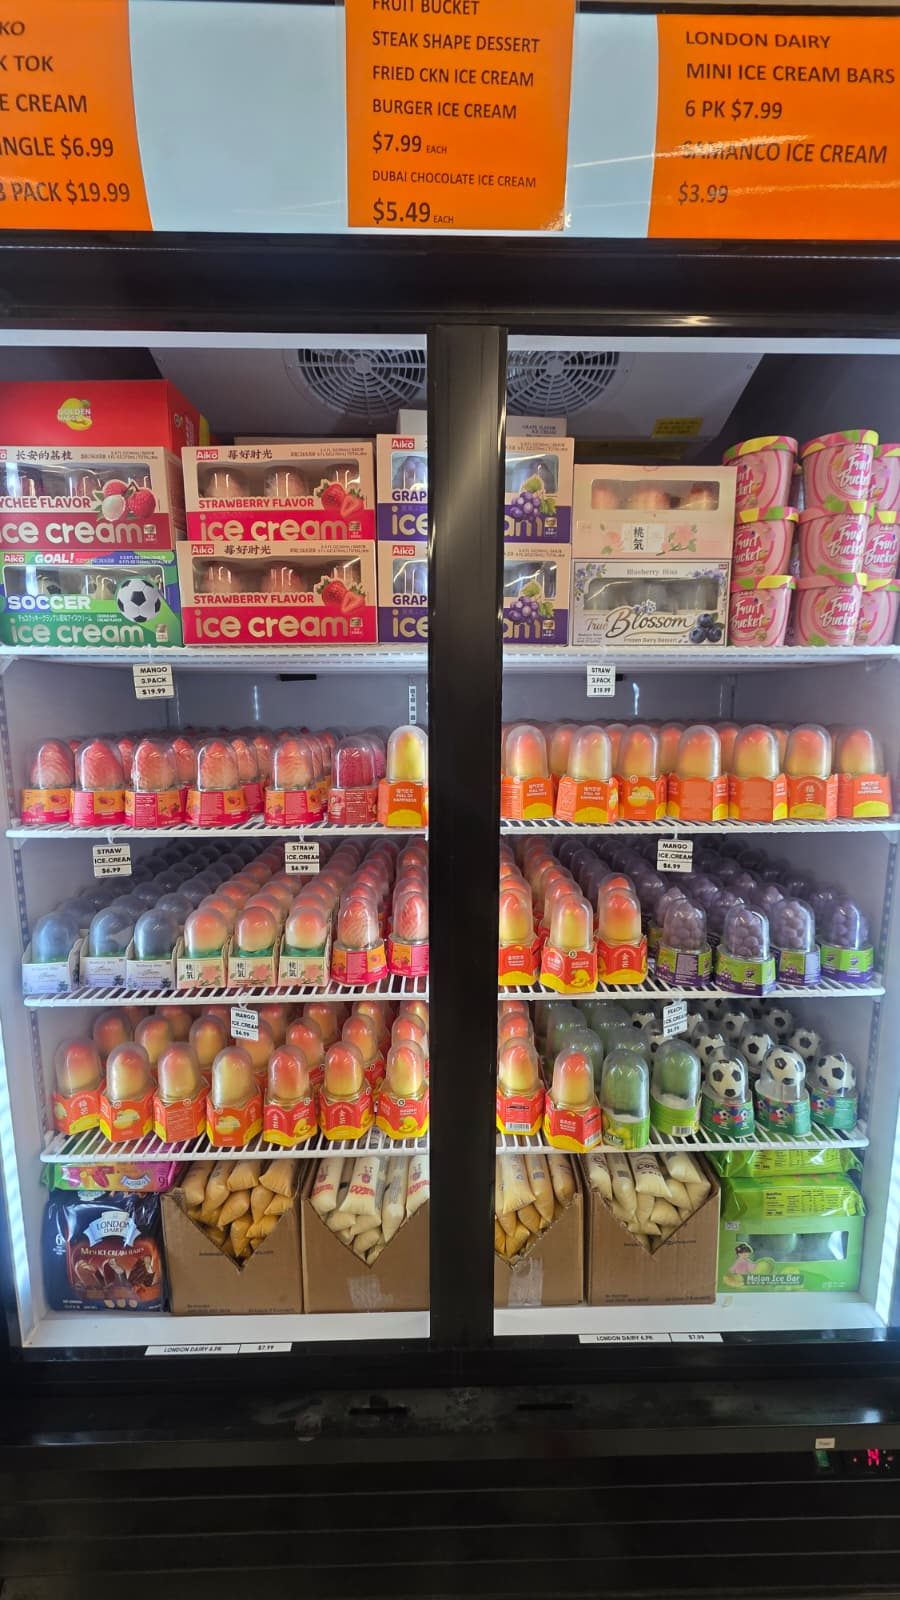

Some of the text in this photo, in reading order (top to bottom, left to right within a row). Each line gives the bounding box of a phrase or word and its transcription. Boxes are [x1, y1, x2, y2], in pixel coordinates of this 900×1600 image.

[372, 0, 480, 15] FRUIT BUCKET
[372, 31, 540, 53] STEAK SHAPE DESSERT
[685, 31, 831, 49] LONDON DAIRY
[14, 55, 54, 72] TOK
[372, 66, 534, 87] FRIED CKN ICE CREAM
[686, 63, 895, 84] MINI ICE CREAM BARS
[16, 94, 88, 113] CREAM
[373, 99, 517, 119] BURGER ICE CREAM
[685, 98, 783, 122] 6 PK $7.99
[60, 134, 114, 160] $6.99
[372, 131, 447, 154] $7.99 EACH
[786, 144, 814, 163] ICE
[819, 144, 888, 164] CREAM
[372, 170, 536, 188] DUBAI CHOCOLATE ICE CREAM
[12, 182, 62, 202] PACK
[66, 180, 130, 205] $19.99
[678, 181, 729, 205] $3.99
[373, 198, 454, 224] $5.49 EACH
[392, 440, 415, 449] Aiko
[197, 450, 218, 460] Aiko
[40, 498, 91, 509] FLAVOR
[199, 498, 314, 509] STRAWBERRY FLAVOR
[392, 491, 427, 502] GRAP
[45, 521, 143, 544] cream
[200, 514, 348, 541] ice cream
[4, 553, 25, 563] Aiko
[35, 553, 75, 564] GOAL!
[192, 545, 214, 555] Aiko
[392, 546, 415, 556] Aiko
[8, 595, 91, 610] SOCCER
[194, 594, 314, 604] STRAWBERRY FLAVOR
[392, 594, 427, 606] GRAP
[10, 618, 145, 643] ice cream
[194, 609, 349, 638] ice cream
[605, 606, 694, 639] Blossom
[96, 847, 122, 855] STRAW
